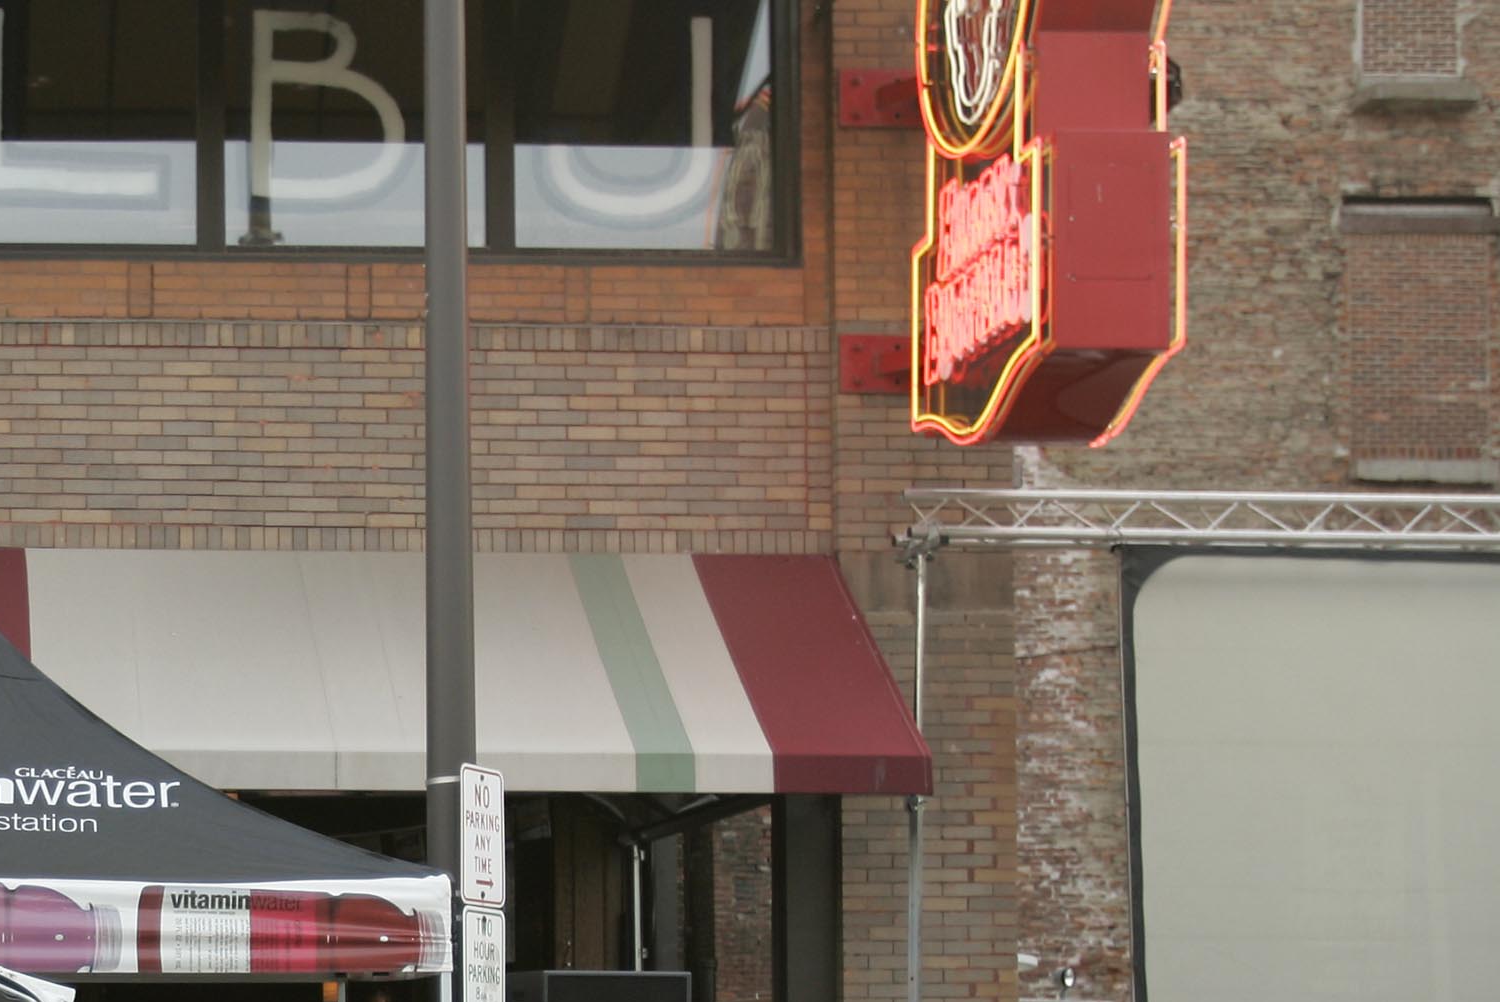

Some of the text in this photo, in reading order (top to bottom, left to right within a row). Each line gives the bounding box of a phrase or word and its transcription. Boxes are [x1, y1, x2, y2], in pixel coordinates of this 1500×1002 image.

[15, 766, 103, 780] GLACÉAU
[474, 784, 490, 808] NO
[466, 809, 500, 832] PARKING
[474, 835, 492, 852] ANY
[474, 855, 492, 874] TIME
[171, 888, 302, 911] vitaminwater
[476, 917, 493, 937] TWO
[473, 940, 495, 960] HOUR
[468, 963, 501, 985] PARKING
